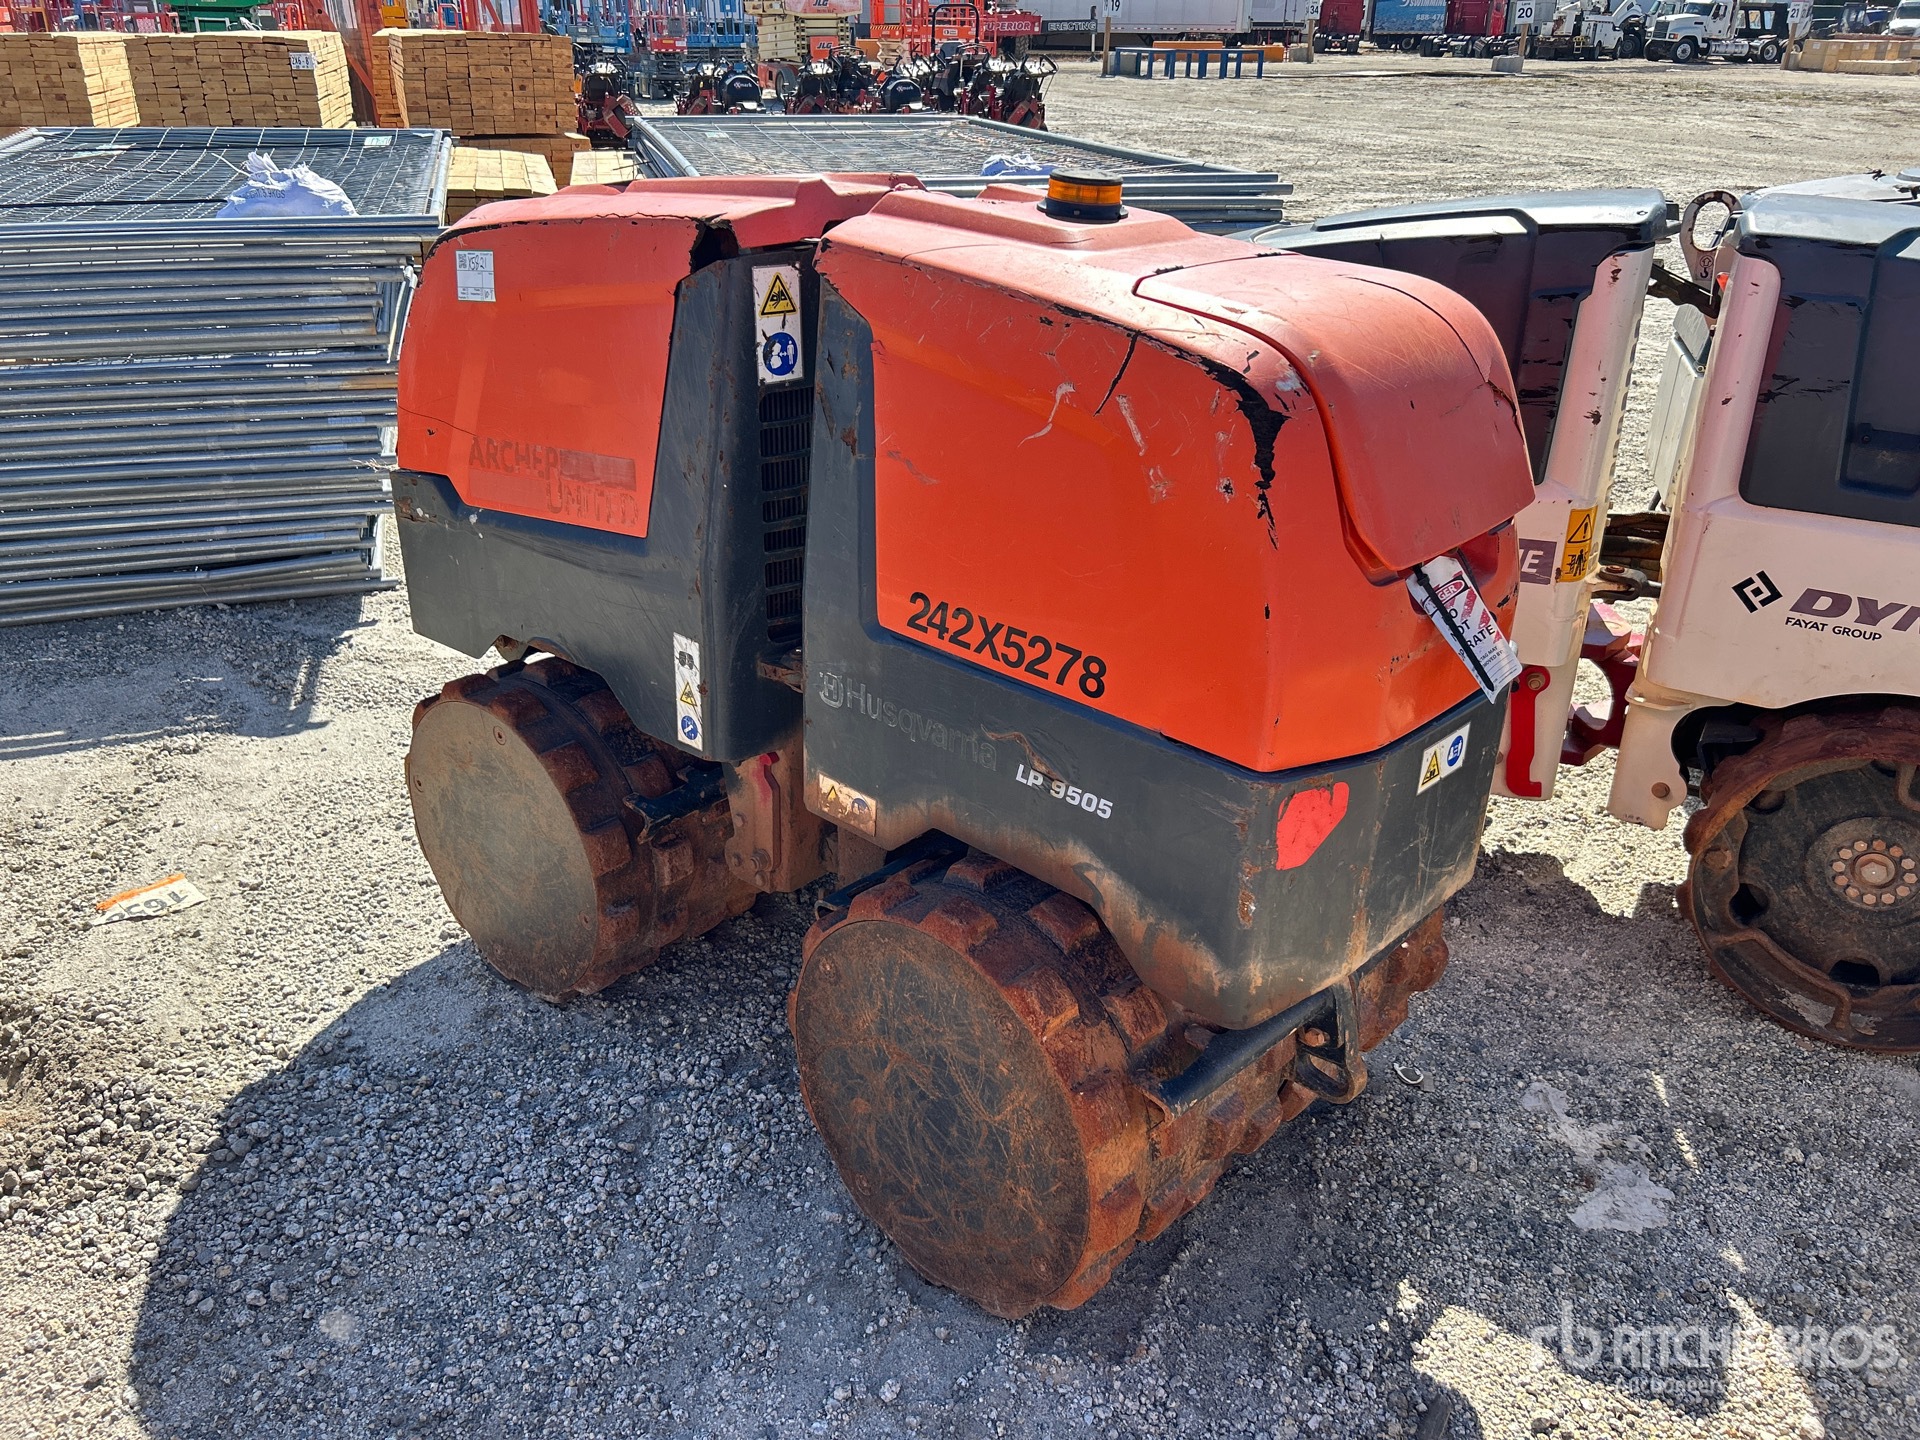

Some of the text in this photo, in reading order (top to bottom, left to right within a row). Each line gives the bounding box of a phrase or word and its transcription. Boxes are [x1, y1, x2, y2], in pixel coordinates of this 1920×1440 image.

[1111, 0, 1121, 12] 19
[1310, 5, 1319, 15] 34
[1517, 7, 1533, 19] 20
[1790, 8, 1800, 19] 21
[1047, 22, 1096, 31] ERECTING
[545, 467, 640, 528] UNITD
[1785, 616, 1882, 641] FAYAT GROUP
[906, 590, 1109, 700] 242X5278
[846, 678, 998, 772] Husqvarna
[1015, 763, 1113, 820] LP 9505
